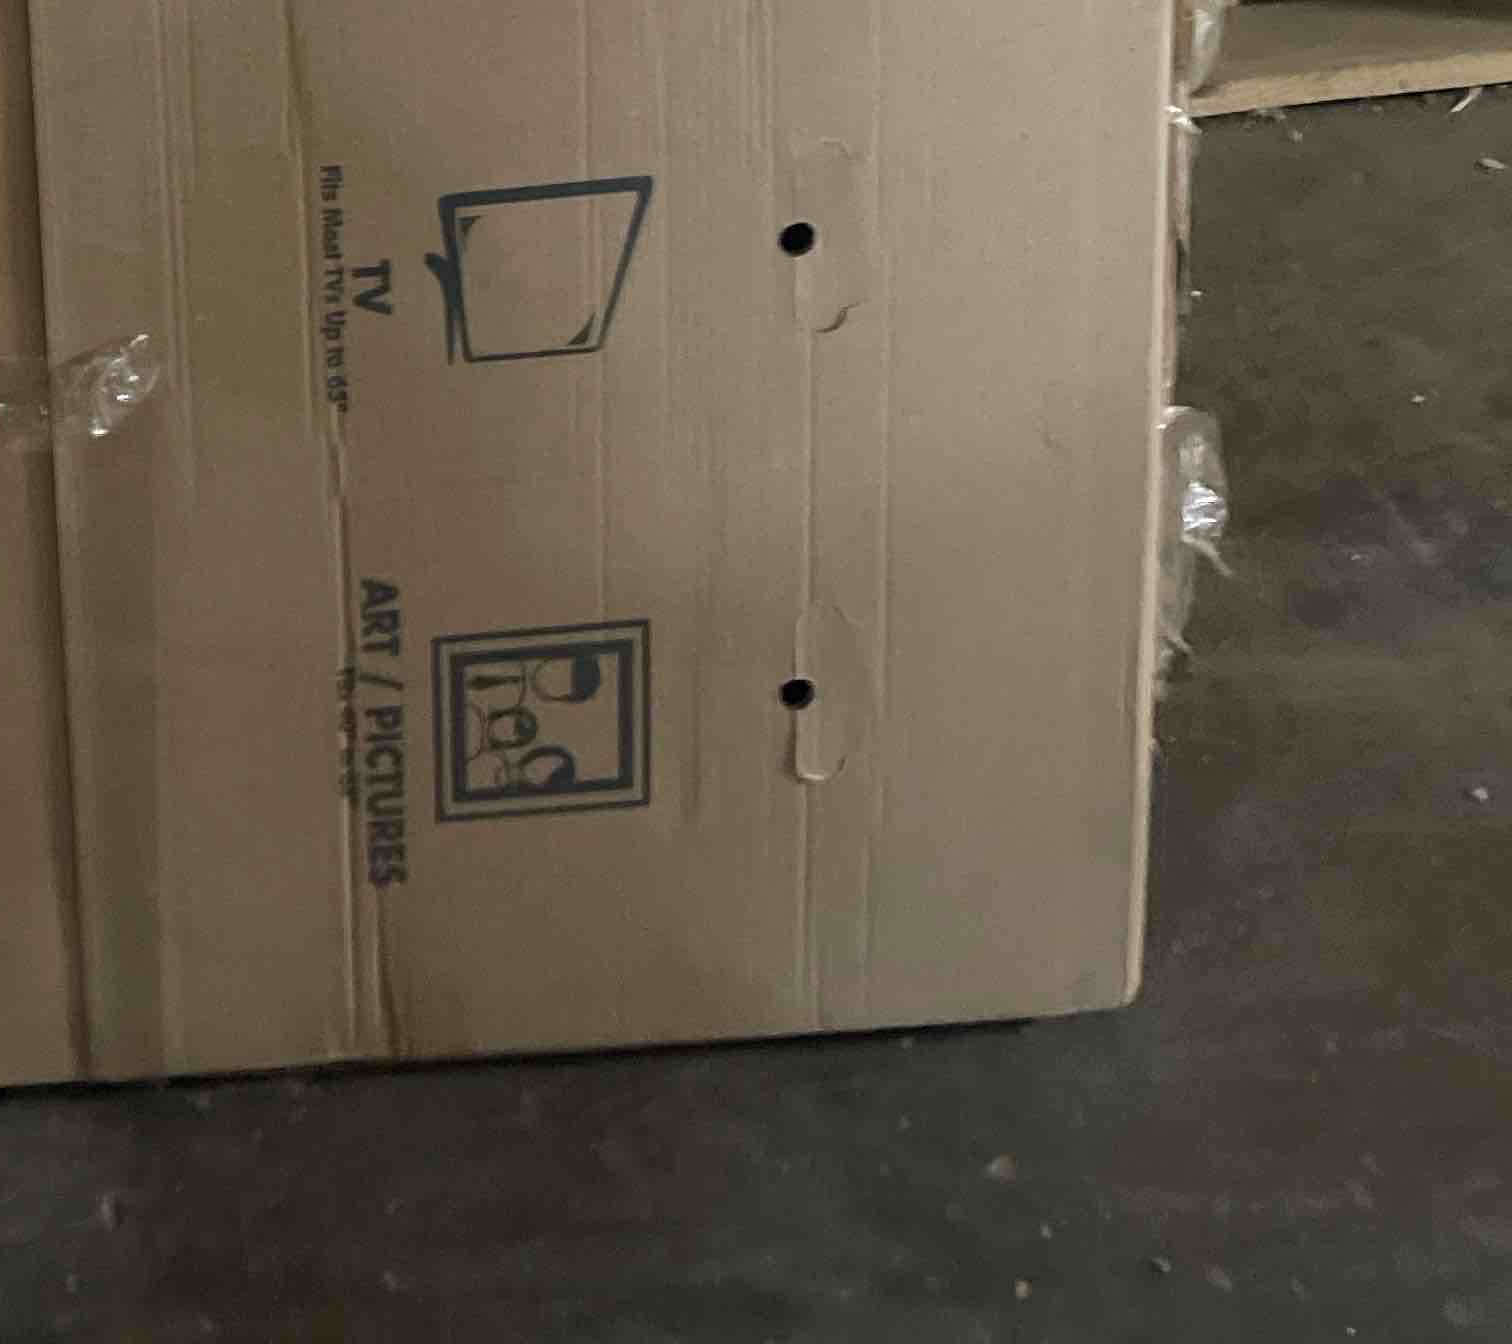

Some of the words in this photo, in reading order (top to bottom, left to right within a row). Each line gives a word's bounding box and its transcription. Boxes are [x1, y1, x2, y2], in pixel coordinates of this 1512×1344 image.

[320, 165, 343, 201] Fits
[321, 208, 344, 259] Most
[352, 259, 393, 315] TV
[321, 312, 346, 341] Up
[327, 346, 345, 368] to
[361, 579, 400, 656] ART
[365, 705, 407, 888] PICTURES
